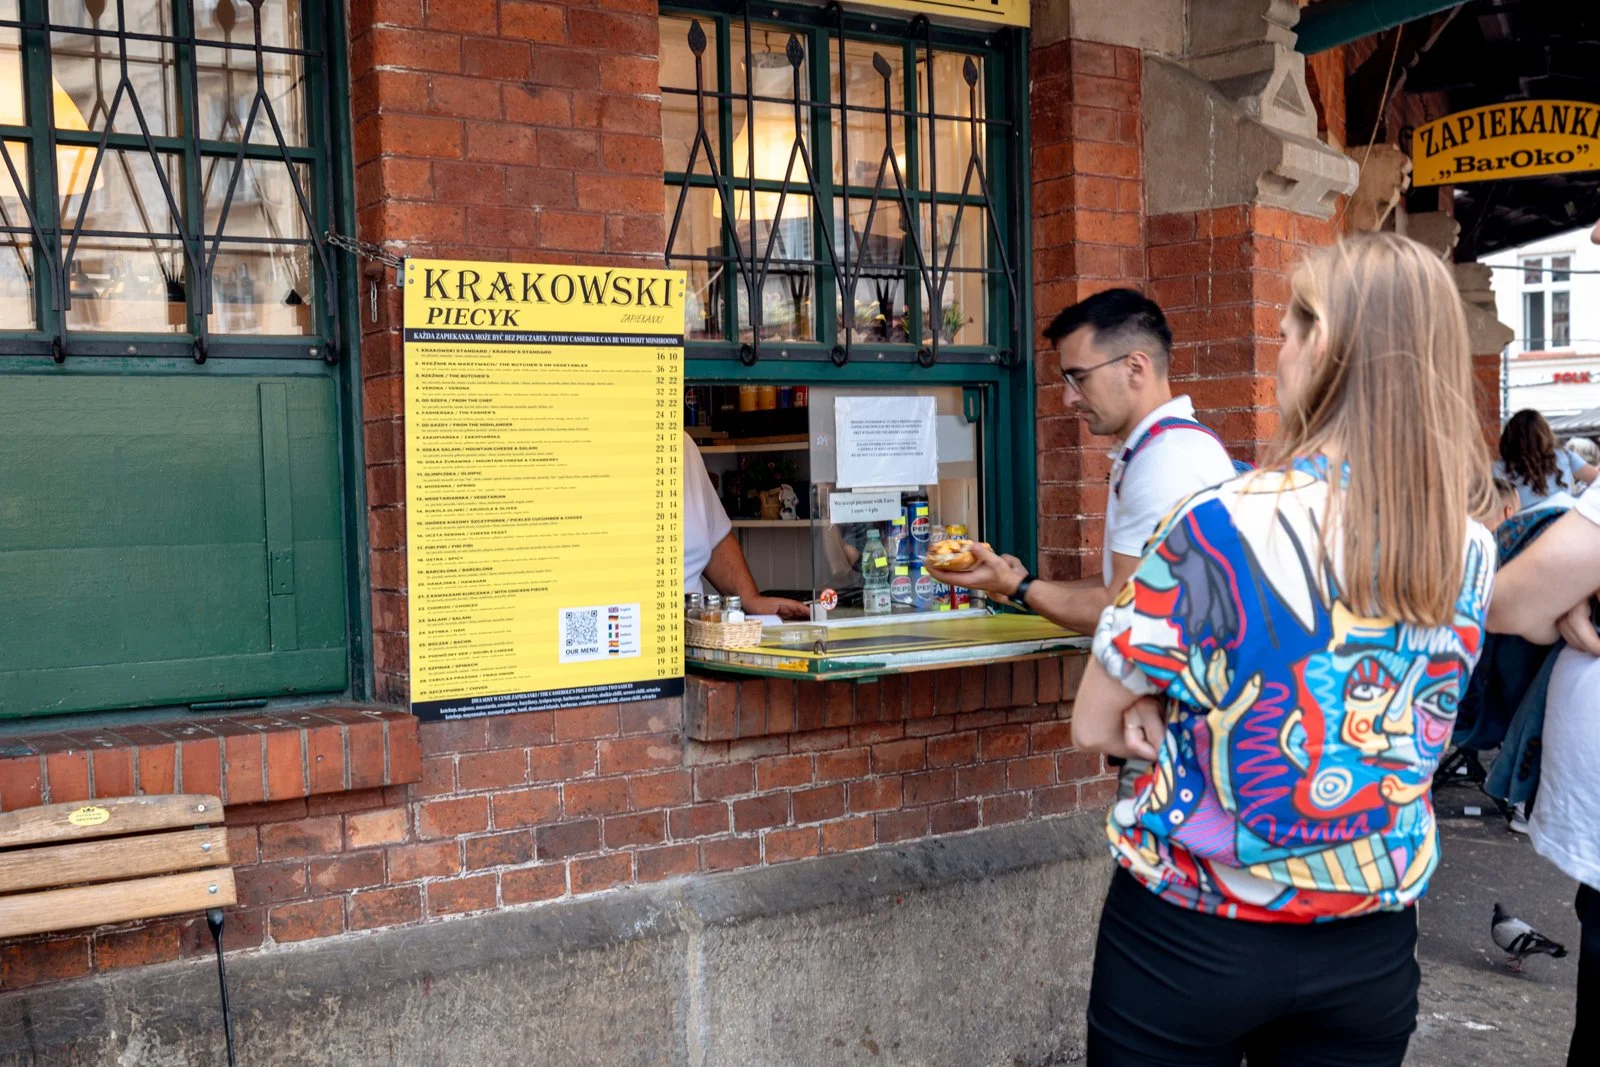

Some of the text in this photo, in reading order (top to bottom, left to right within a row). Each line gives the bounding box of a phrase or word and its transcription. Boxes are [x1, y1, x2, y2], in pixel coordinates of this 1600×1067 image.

[424, 268, 673, 307] KRAKOWSKI
[426, 307, 521, 326] PIECYK
[413, 330, 435, 339] KAŻDA
[436, 332, 474, 340] ZAPIEKANKA
[474, 332, 491, 340] MOŻE
[516, 334, 547, 342] PIECZAREK
[569, 335, 599, 343] CASSEROLE
[620, 336, 645, 344] WITHOUT
[670, 556, 677, 564] 17
[656, 568, 664, 576] 24
[932, 584, 951, 594] FAN
[656, 624, 664, 632] 20
[656, 635, 665, 643] 20
[657, 646, 665, 654] 20
[657, 668, 665, 676] 19
